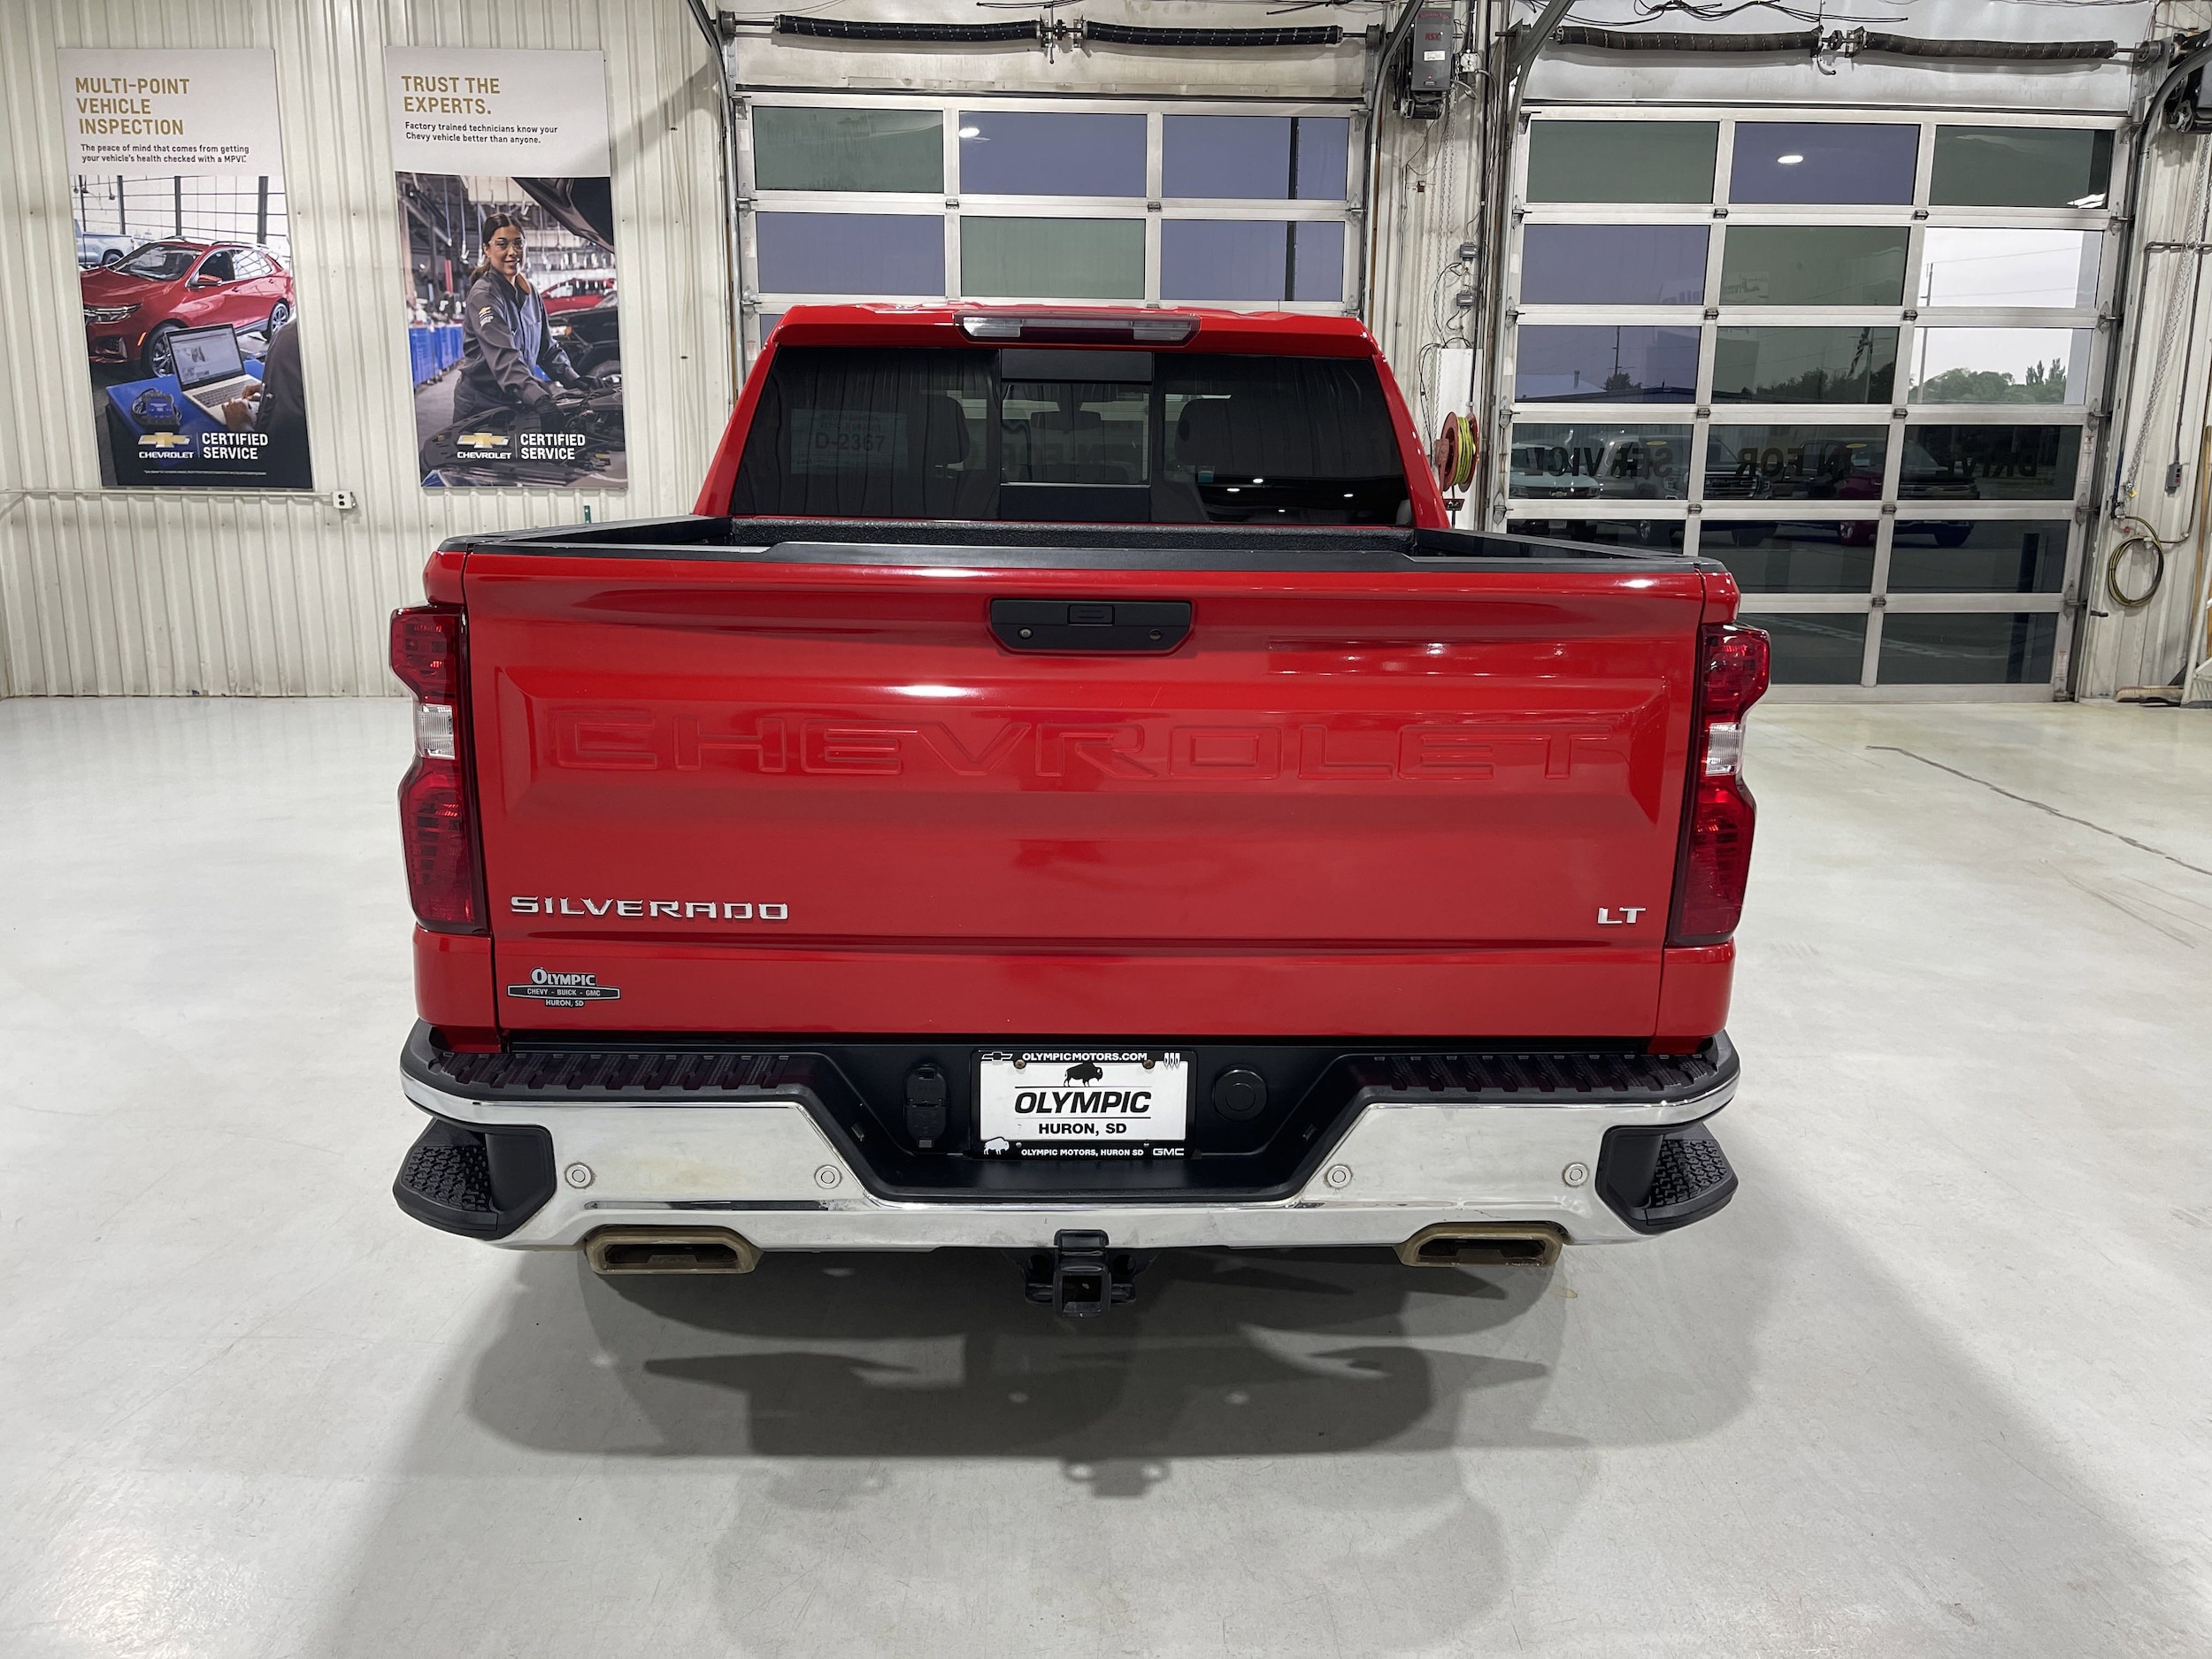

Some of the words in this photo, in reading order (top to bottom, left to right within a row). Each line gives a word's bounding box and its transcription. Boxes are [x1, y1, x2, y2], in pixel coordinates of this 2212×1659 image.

[75, 77, 189, 95] MULTI-POINT
[401, 76, 459, 93] TRUST
[465, 77, 501, 94] THE
[77, 98, 151, 114] VEHICLE
[403, 96, 492, 115] EXPERTS.
[80, 119, 184, 135] INSPECTION
[405, 121, 436, 132] Factory
[438, 123, 467, 132] trained
[469, 123, 515, 133] technicians
[517, 124, 537, 134] know
[540, 127, 557, 135] your
[406, 132, 431, 142] Chevy
[433, 133, 461, 142] vehicle
[463, 134, 488, 142] better
[490, 134, 508, 143] than
[220, 145, 250, 155] getting
[202, 433, 268, 446] CERTIFIED
[520, 434, 586, 447] CERTIFIED
[816, 432, 886, 452] D-2367
[203, 447, 258, 460] SERVICE
[521, 447, 575, 460] SERVICE
[554, 711, 1612, 780] CHEVROLET
[511, 895, 788, 920] SILVERADO
[1597, 907, 1647, 925] LT
[1022, 1052, 1148, 1062] OLYMPICMOTORS.COM
[1014, 1091, 1151, 1114] OLYMPIC
[1039, 1123, 1100, 1137] HURON,
[1106, 1123, 1127, 1134] SD
[1060, 1148, 1099, 1157] MOTORS,
[1152, 1148, 1185, 1156] GMC
